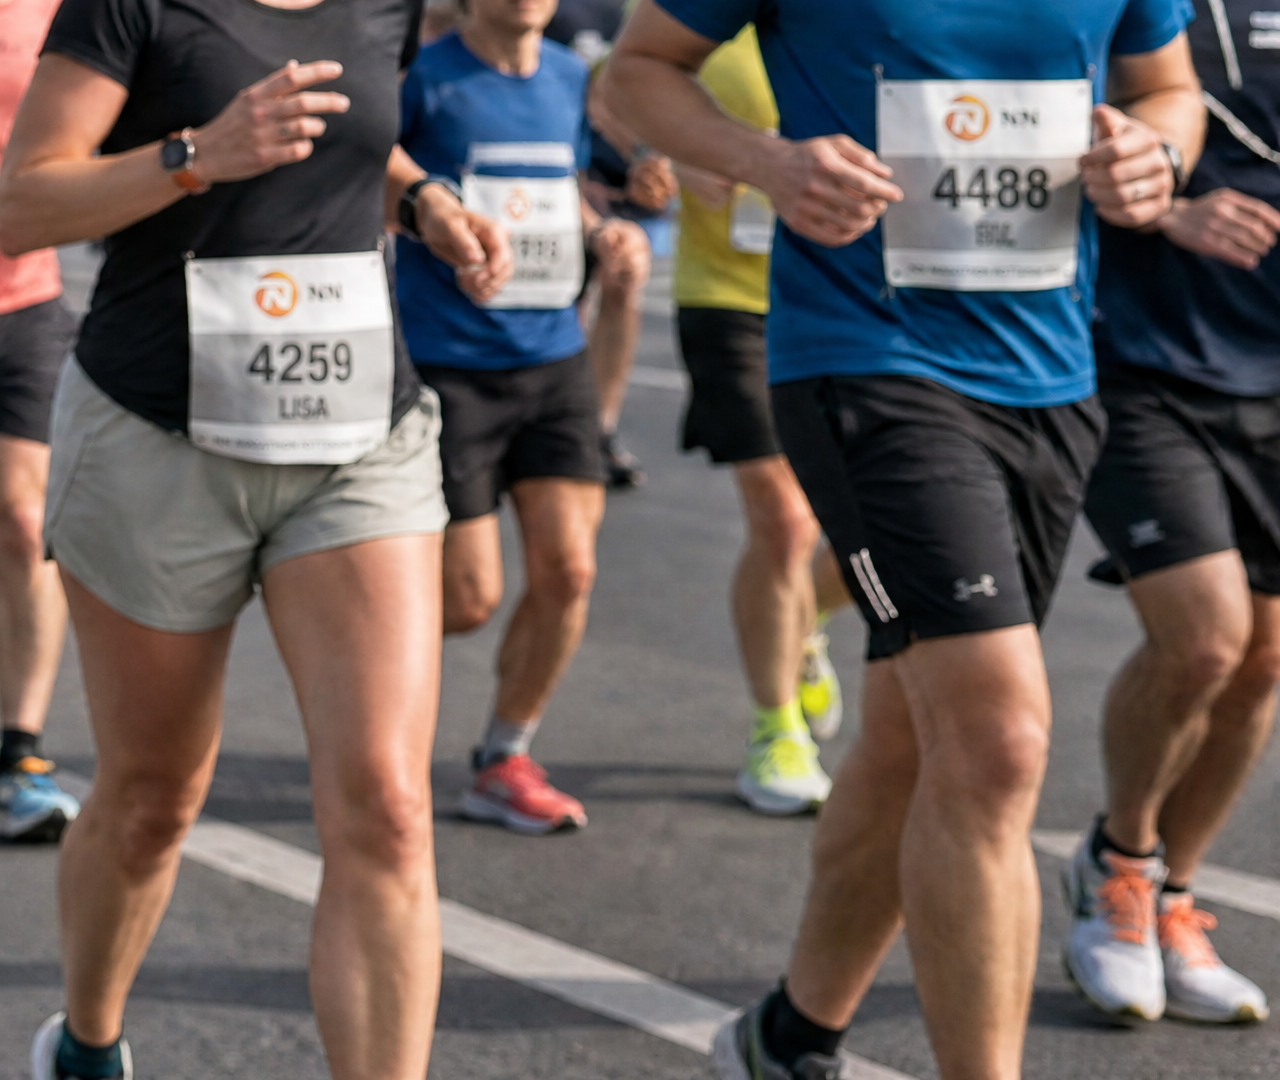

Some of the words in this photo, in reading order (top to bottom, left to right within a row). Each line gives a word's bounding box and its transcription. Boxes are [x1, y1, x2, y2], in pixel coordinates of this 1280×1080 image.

[932, 167, 1051, 210] 4488
[246, 342, 354, 384] 4259
[278, 395, 329, 420] LISA
